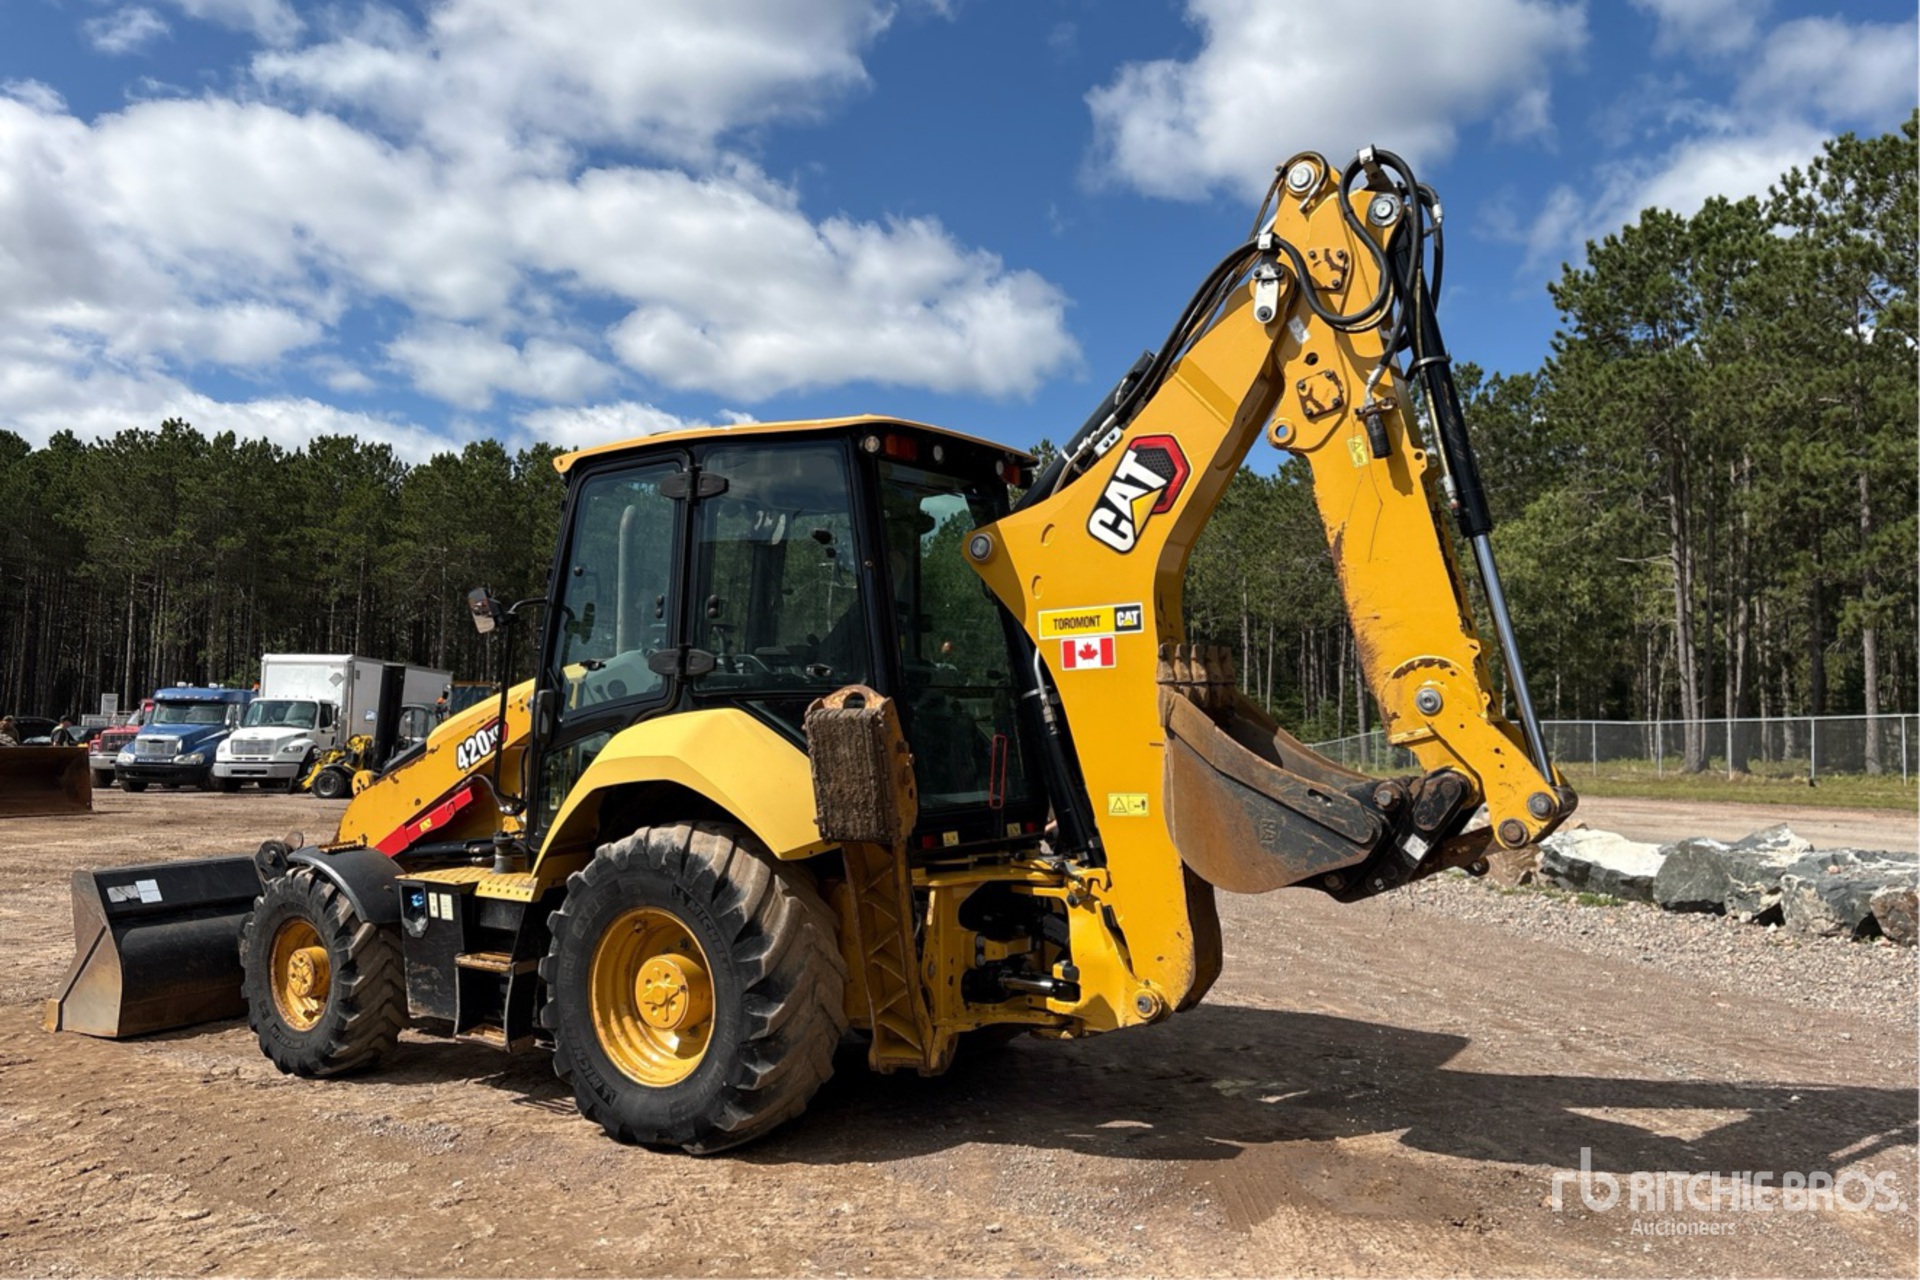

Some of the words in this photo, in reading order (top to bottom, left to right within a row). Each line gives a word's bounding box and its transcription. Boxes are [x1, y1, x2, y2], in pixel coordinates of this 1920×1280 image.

[1088, 449, 1168, 552] CAT
[1053, 615, 1101, 631] TOROMONT
[1116, 610, 1141, 627] CAT
